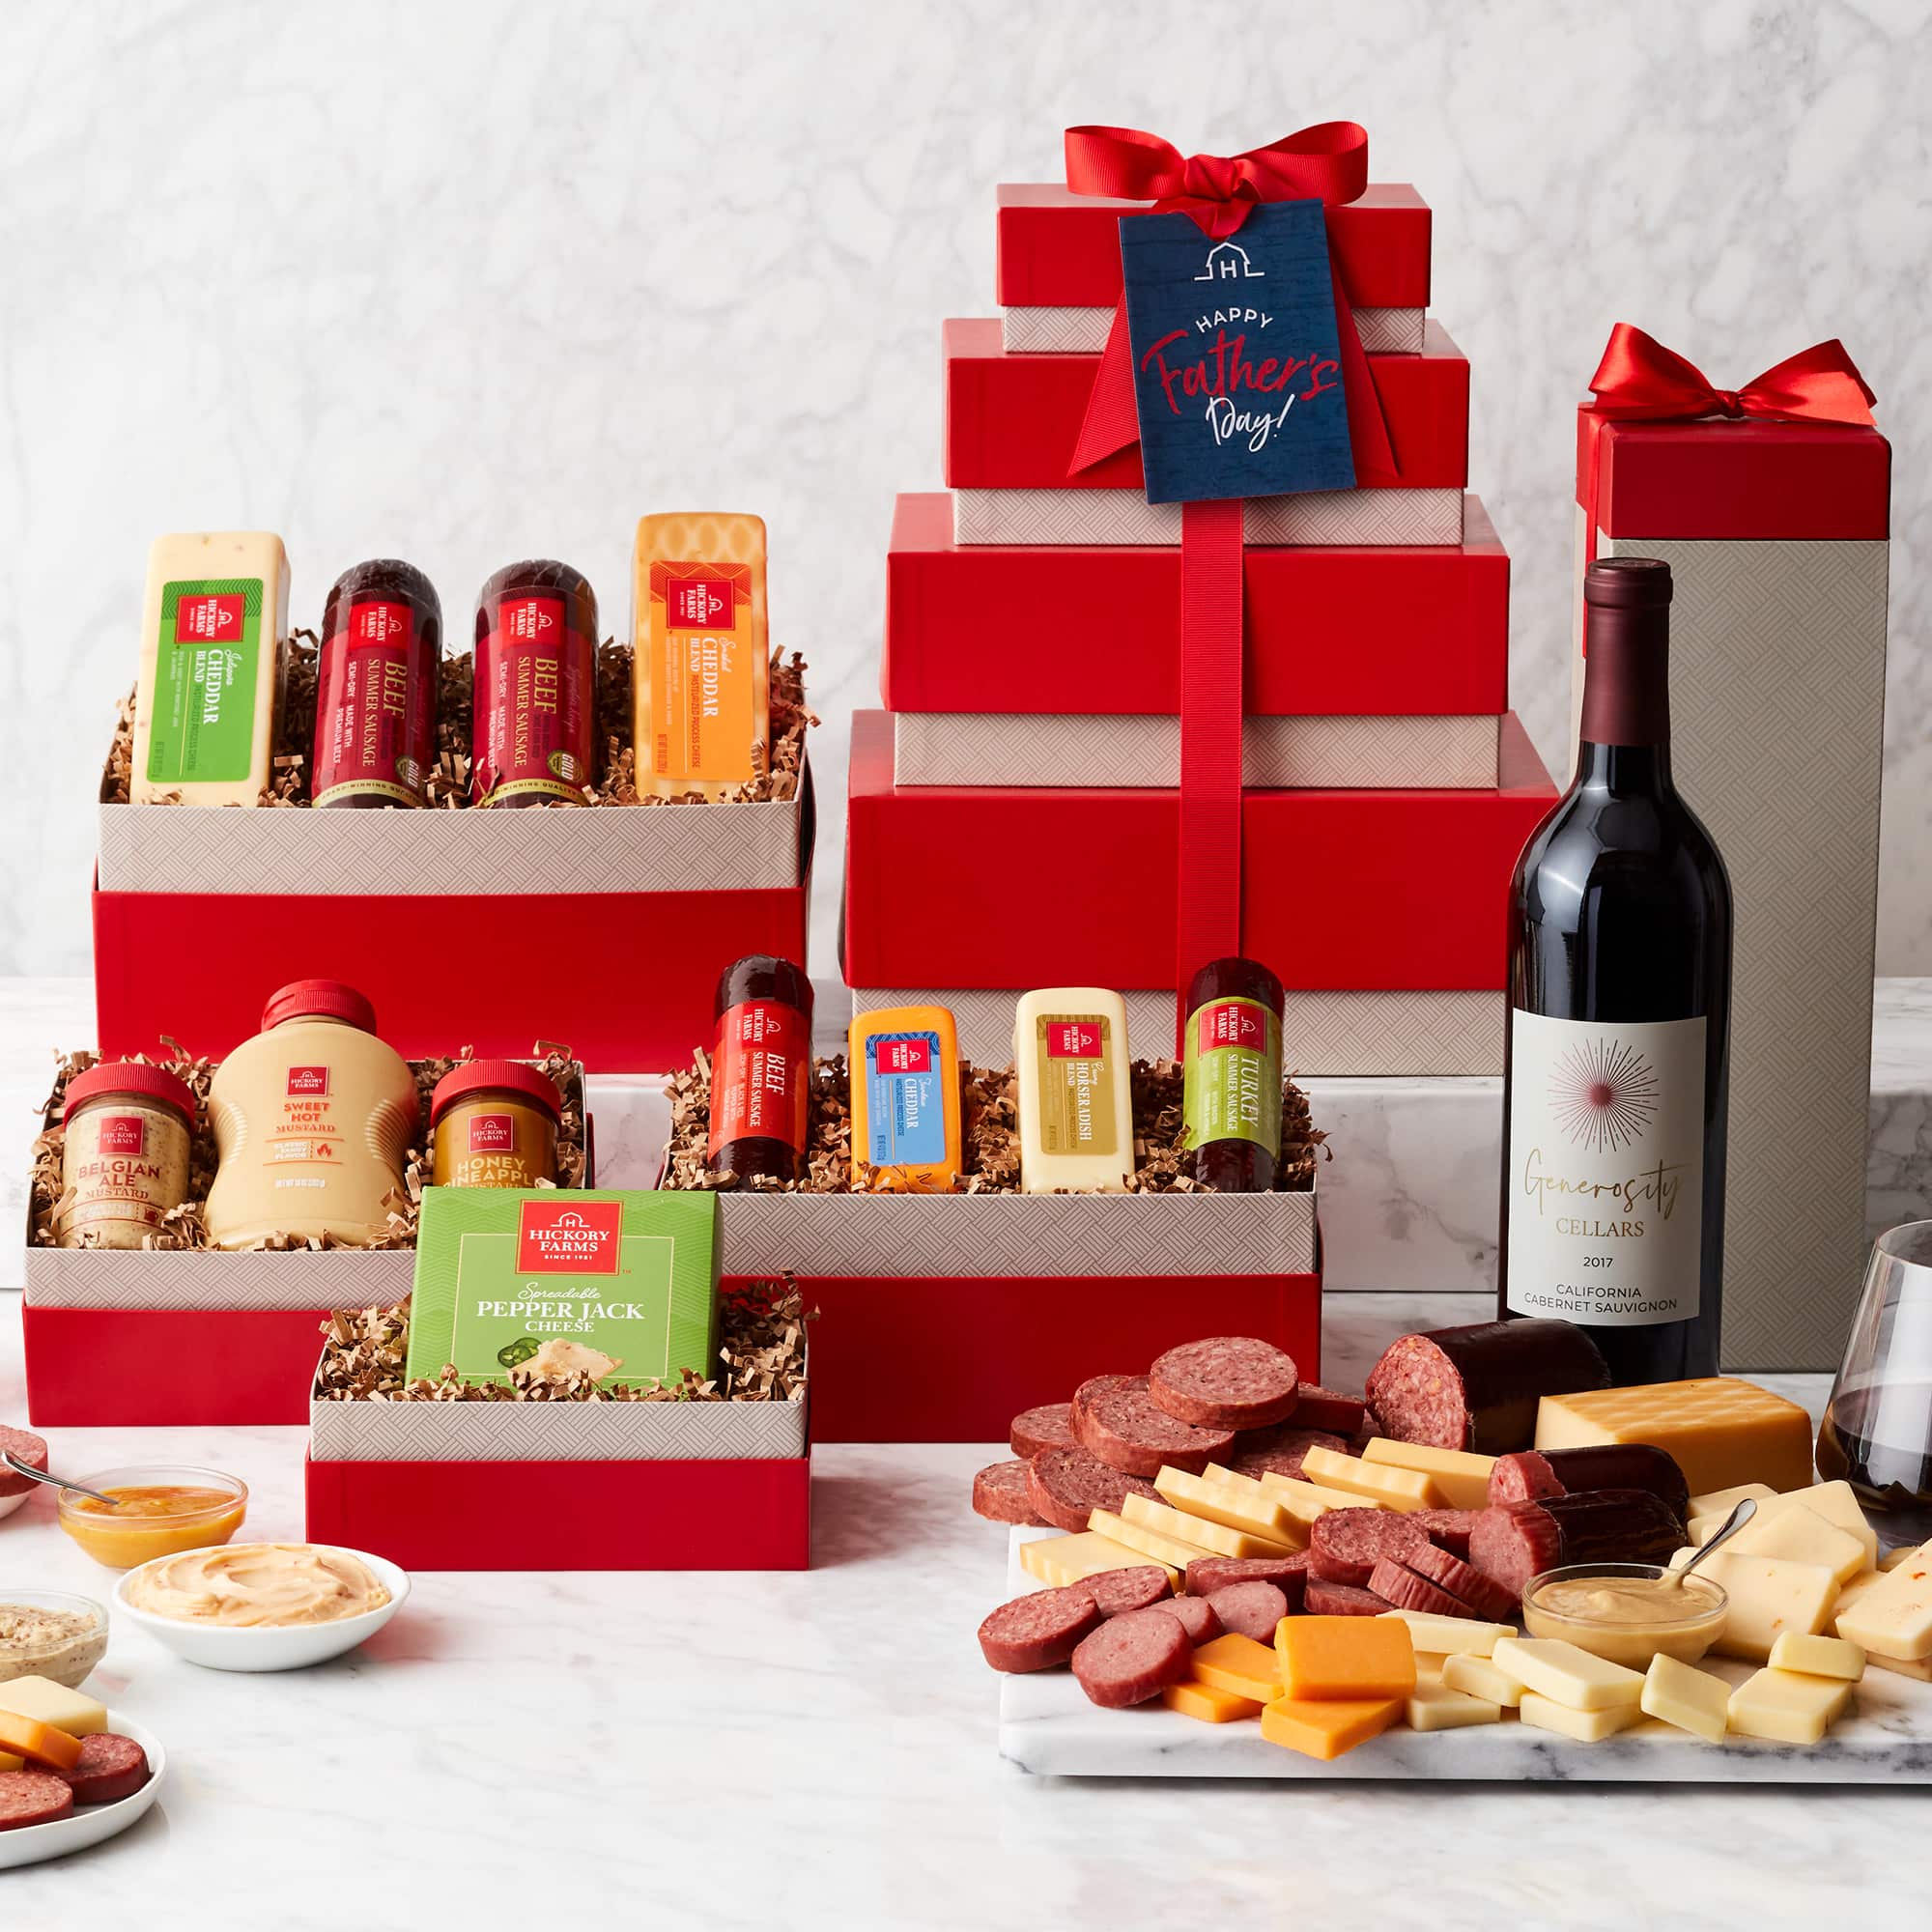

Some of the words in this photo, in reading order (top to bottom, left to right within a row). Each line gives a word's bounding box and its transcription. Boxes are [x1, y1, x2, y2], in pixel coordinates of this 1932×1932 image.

[1195, 307, 1274, 332] HAPPY
[1141, 329, 1340, 414] Father's
[1206, 393, 1295, 453] Day!
[196, 605, 206, 633] FARMS
[206, 599, 216, 638] HICKORY
[687, 589, 696, 619] FARMS
[696, 584, 706, 624] HICKORY
[367, 611, 377, 639] FARMS
[377, 607, 386, 641] HICKORY
[517, 609, 526, 637] FARMS
[526, 603, 536, 639] HICKORY
[194, 650, 206, 683] BLEND
[690, 638, 699, 671] BLEND
[719, 637, 736, 672] Smoked
[203, 649, 223, 724] CHEDDAR
[347, 661, 356, 697] SEMI-DRY
[365, 659, 379, 711] SUMMER
[383, 661, 408, 720] BEEF
[498, 661, 507, 697] SEMI-DRY
[516, 657, 530, 710] SUMMER
[533, 657, 558, 715] BEEF
[703, 637, 718, 717] CHEDDAR
[691, 674, 699, 716] PASTEURIZED
[334, 708, 343, 744] PREMIUM
[344, 705, 355, 726] MADE
[497, 705, 505, 729] MADE
[344, 728, 353, 748] WITH
[362, 714, 377, 767] SAUSAGE
[514, 713, 528, 768] SAUSAGE
[332, 745, 341, 764] BEEF
[561, 753, 574, 781] GOLD
[692, 745, 700, 768] CHEESE
[408, 759, 419, 787] GOLD
[743, 1014, 753, 1040] FARMS
[753, 1009, 763, 1042] HICKORY
[1071, 1026, 1080, 1053] HICKORY
[1218, 1012, 1227, 1038] FARMS
[1229, 1007, 1238, 1041] HICKORY
[752, 1052, 763, 1088] SUMMER
[766, 1053, 785, 1095] BEEF
[1066, 1063, 1076, 1086] BLEND
[1227, 1054, 1237, 1091] SUMMER
[284, 1102, 330, 1112] SWEET
[905, 1078, 919, 1128] CHEDDAR
[1077, 1063, 1092, 1140] HORSERADISH
[1241, 1058, 1259, 1127] TURKEY
[291, 1113, 321, 1122] HOT
[750, 1090, 761, 1127] SAUSAGE
[1227, 1094, 1237, 1131] SAUSAGE
[276, 1124, 336, 1133] MUSTARD
[78, 1161, 159, 1179] BELGIAN
[99, 1175, 135, 1186] ALE
[457, 1156, 526, 1175] HONEY
[85, 1188, 149, 1199] MUSTARD
[1524, 1148, 1692, 1220] Generosity
[529, 1229, 611, 1241] HICKORY
[1556, 1218, 1645, 1237] CELLARS
[540, 1241, 599, 1252] FARMS
[1583, 1257, 1613, 1268] 2017
[518, 1282, 602, 1302] Spreadable
[1524, 1293, 1590, 1312] CABERNET
[1595, 1299, 1677, 1313] SAUVIGNON
[1556, 1284, 1642, 1298] CALIFORNIA
[476, 1300, 578, 1319] PEPPER
[578, 1303, 645, 1322] JACK
[525, 1321, 595, 1333] CHEESE
